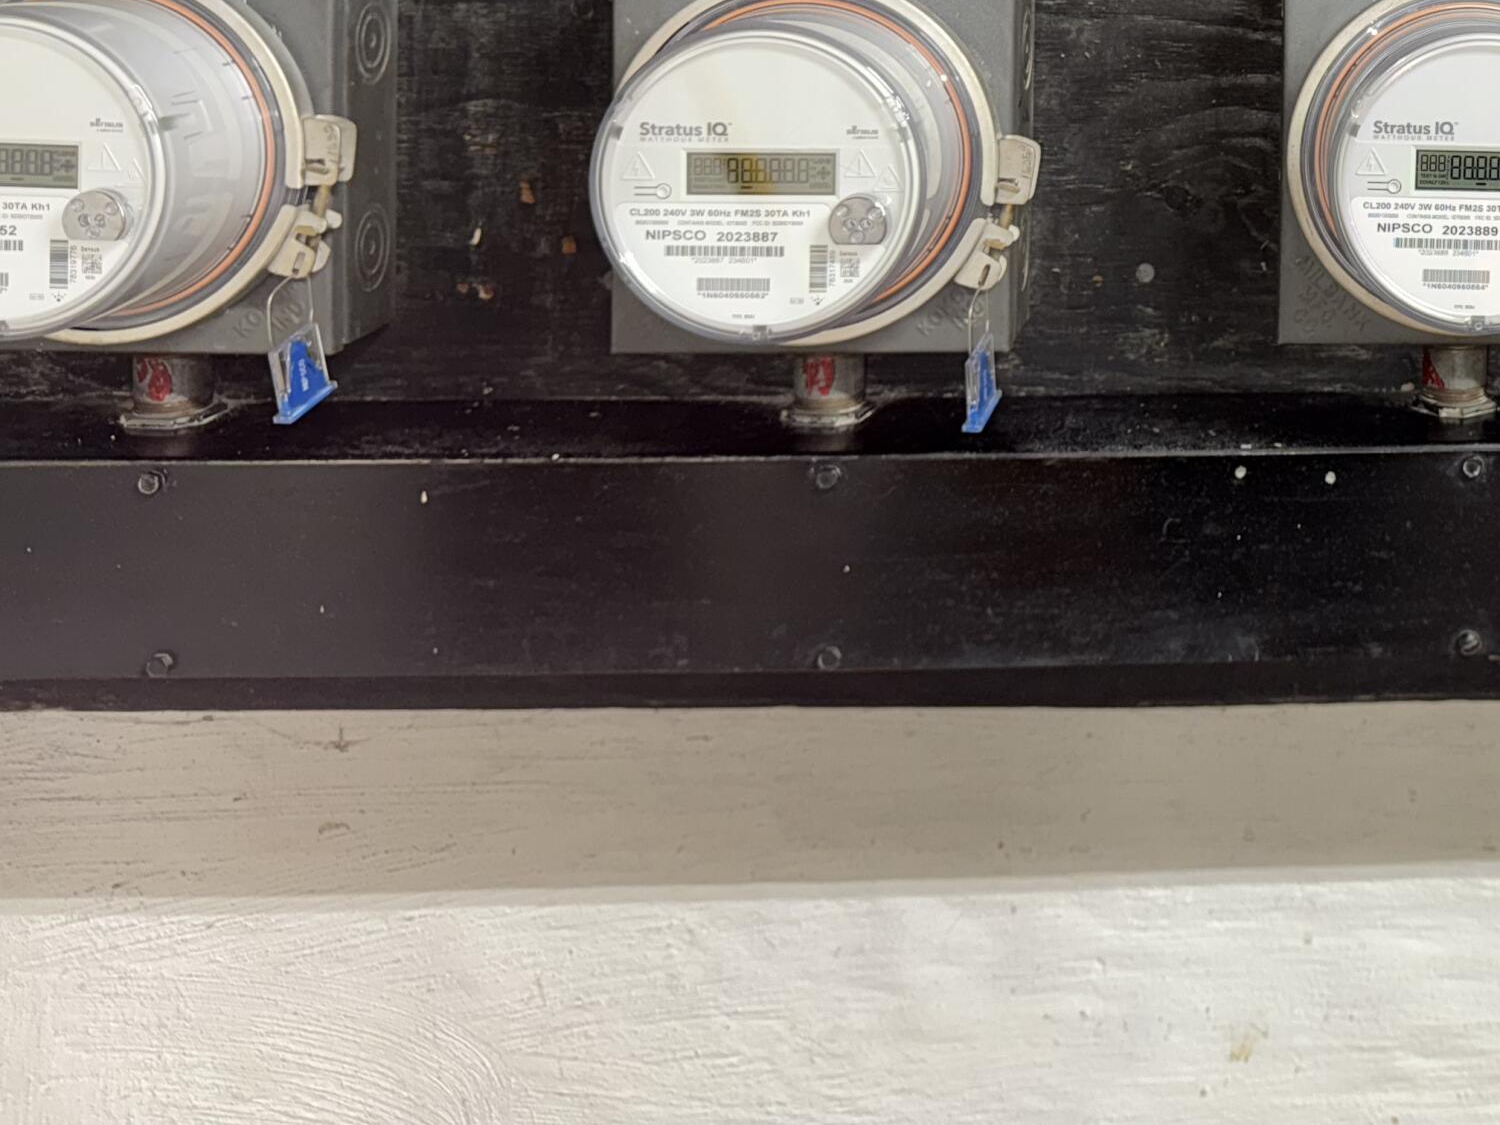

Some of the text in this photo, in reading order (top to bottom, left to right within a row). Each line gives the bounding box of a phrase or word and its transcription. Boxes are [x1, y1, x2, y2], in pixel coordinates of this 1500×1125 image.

[640, 121, 729, 137] Stratus IQ
[1373, 119, 1455, 135] Stratus IQ
[2, 202, 50, 211] 30TA Kh1
[1363, 202, 1391, 210] CL200
[1394, 203, 1416, 211] 240V
[1459, 204, 1483, 212] FM2S
[630, 208, 661, 216] CL200
[690, 209, 705, 217] 3W
[792, 210, 811, 218] Kh1
[1377, 223, 1499, 236] NIPSCO 2023889
[645, 230, 778, 242] NIPSCO 2023887
